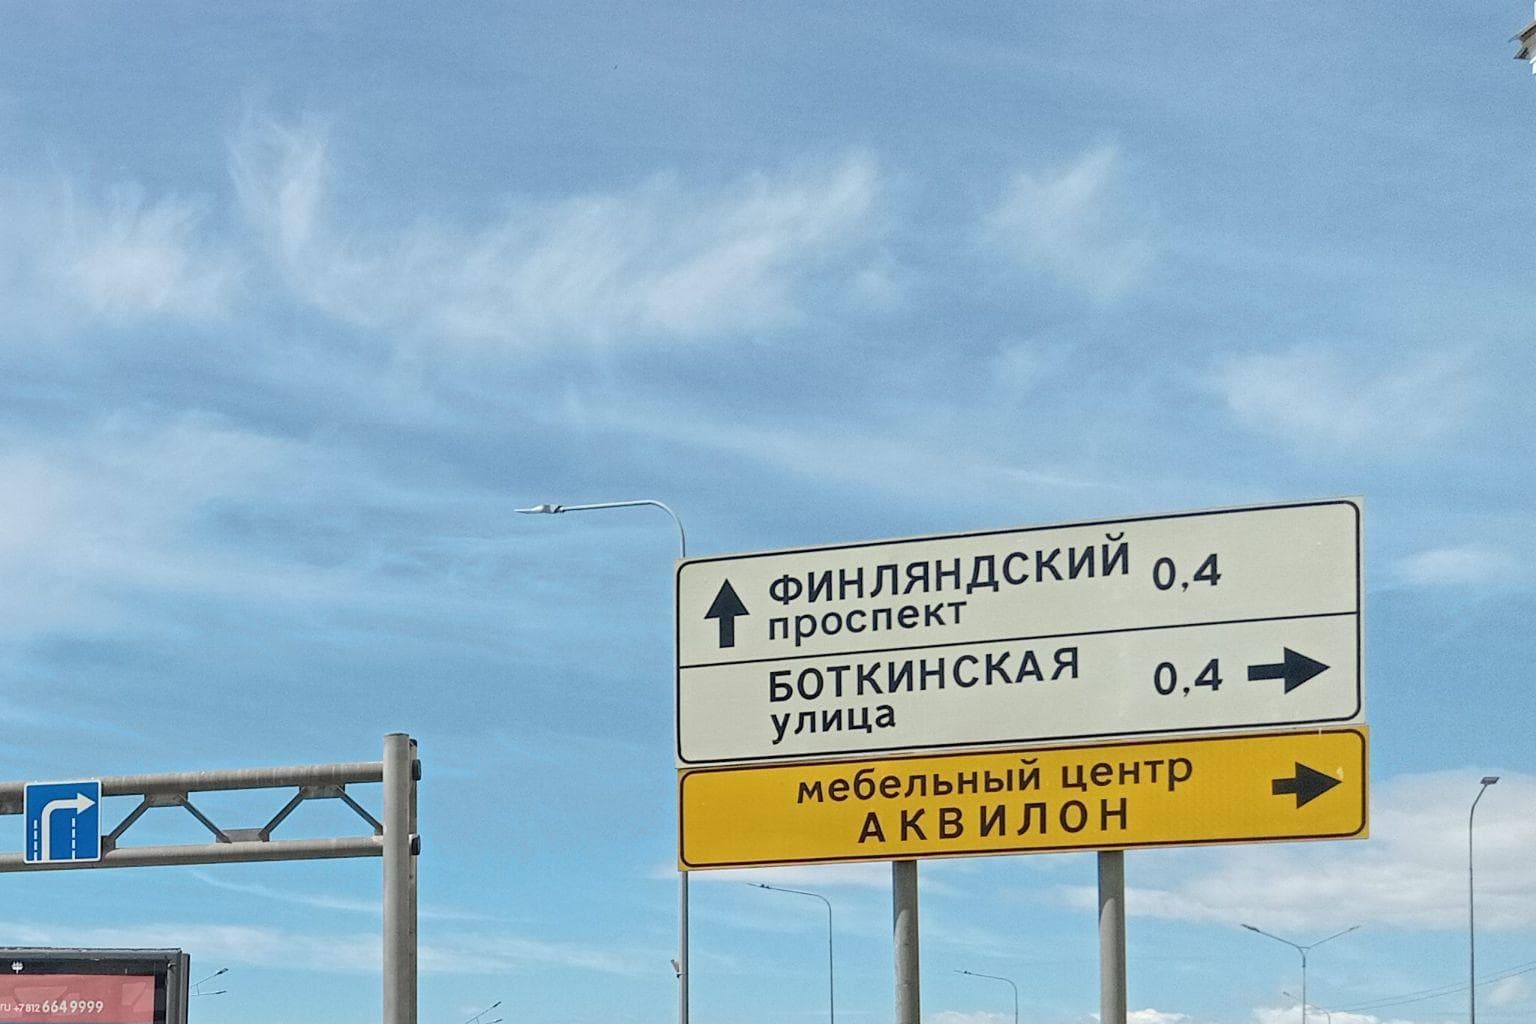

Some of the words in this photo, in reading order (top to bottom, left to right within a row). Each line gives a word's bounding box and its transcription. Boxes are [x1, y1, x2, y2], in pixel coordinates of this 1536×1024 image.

[769, 531, 1131, 606] ФИНЛЯНДСКИЙ
[1152, 553, 1222, 592] 0,4
[768, 601, 968, 647] проспект
[769, 646, 1080, 703] БОТКИНСКАЯ
[1154, 658, 1223, 696] 0,4
[770, 704, 896, 745] улица
[796, 757, 1041, 804] мебельный
[1061, 757, 1194, 793] центр
[857, 797, 1128, 844] АКВИЛОН
[69, 1000, 104, 1014] 9999
